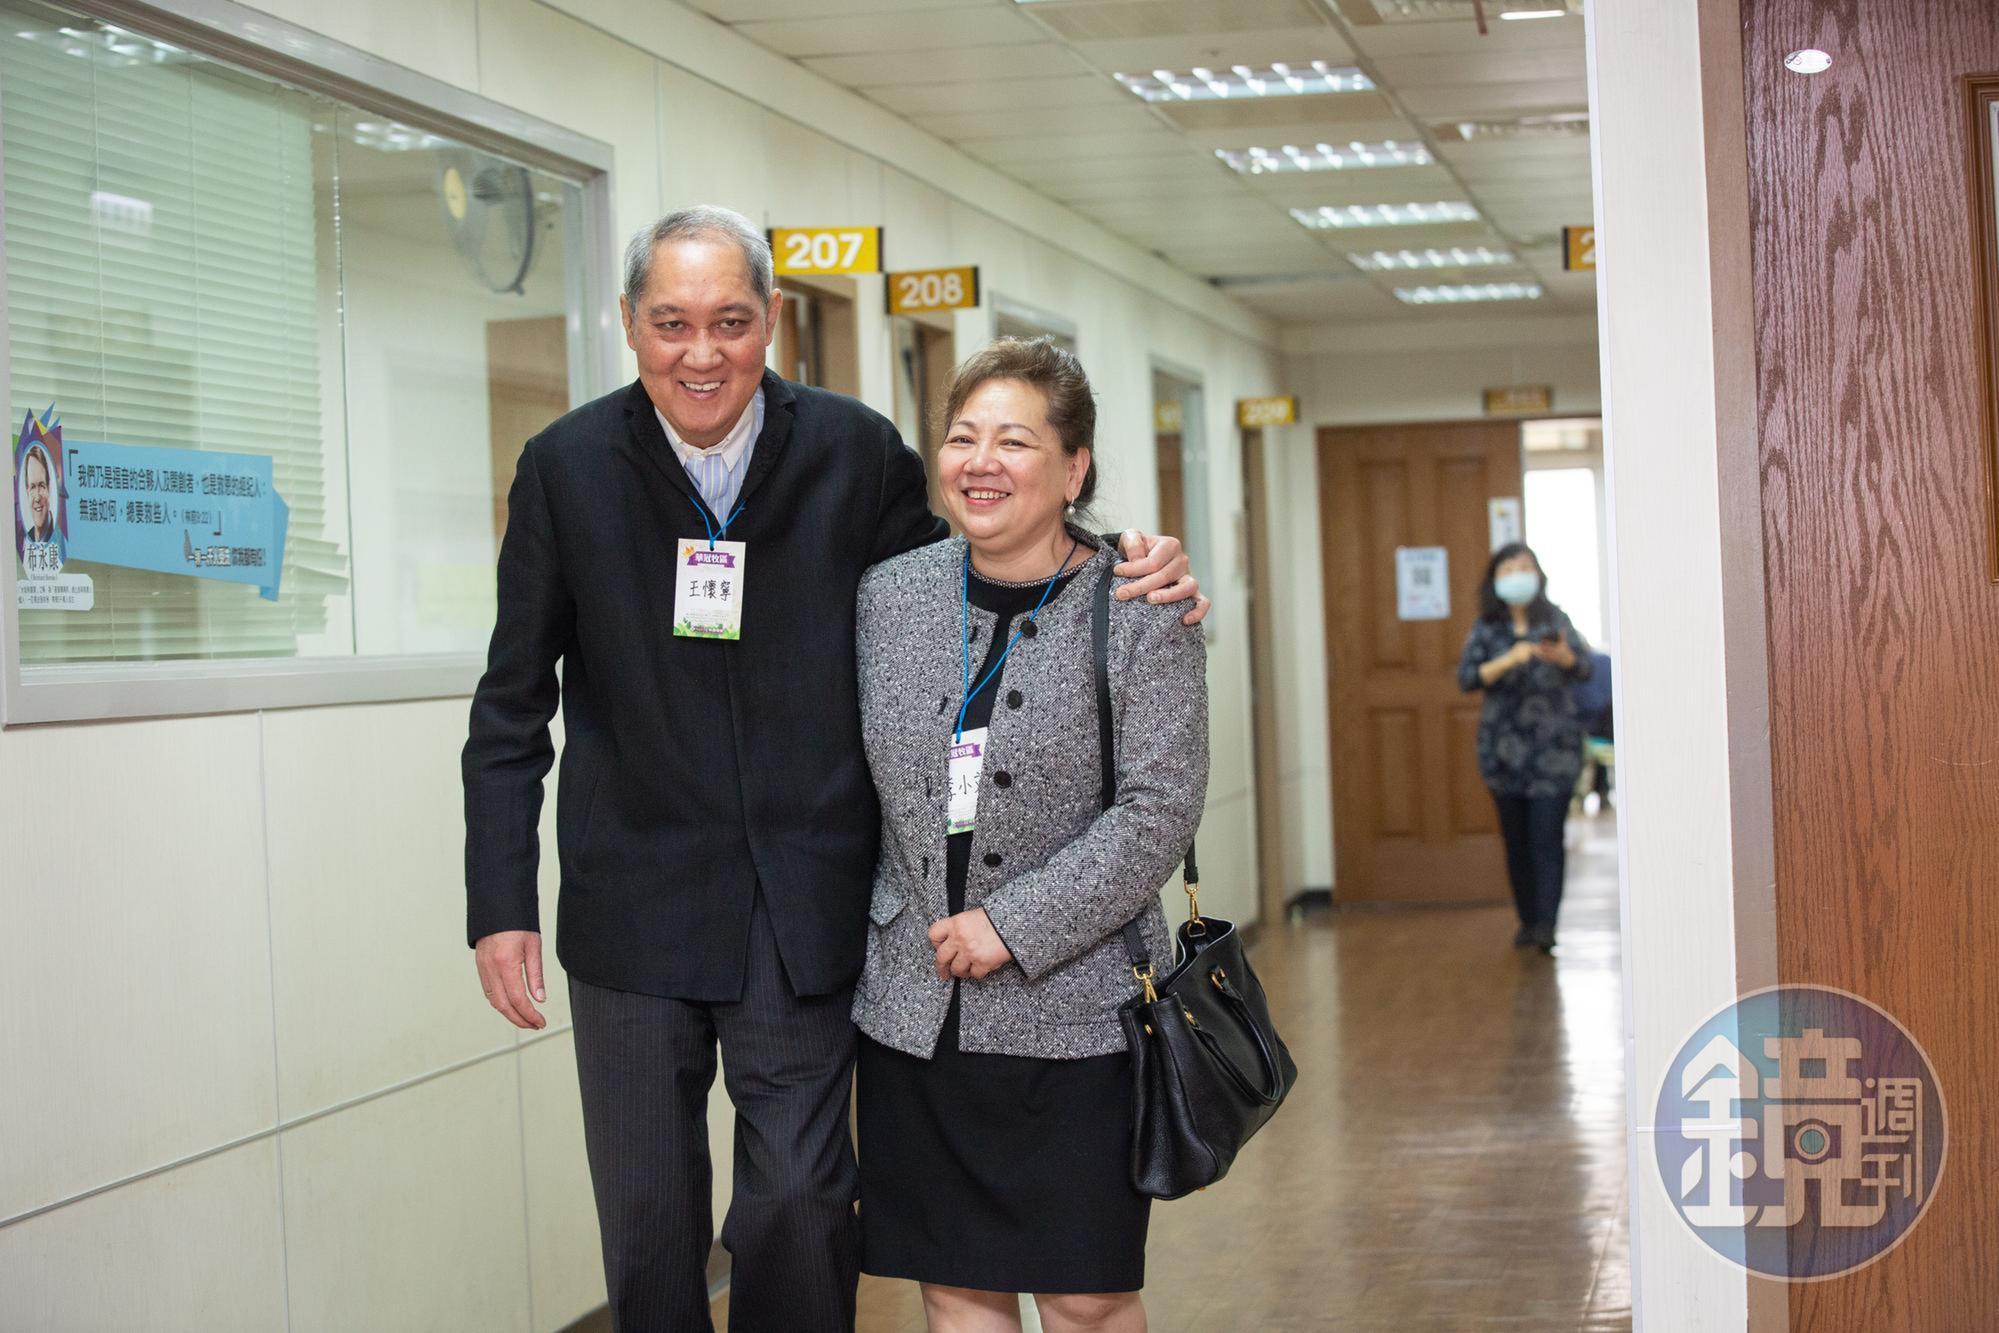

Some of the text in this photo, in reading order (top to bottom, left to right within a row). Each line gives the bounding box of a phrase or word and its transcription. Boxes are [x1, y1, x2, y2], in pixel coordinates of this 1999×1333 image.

[785, 233, 864, 269] 207
[900, 273, 963, 308] 208
[26, 543, 59, 571] 布永康
